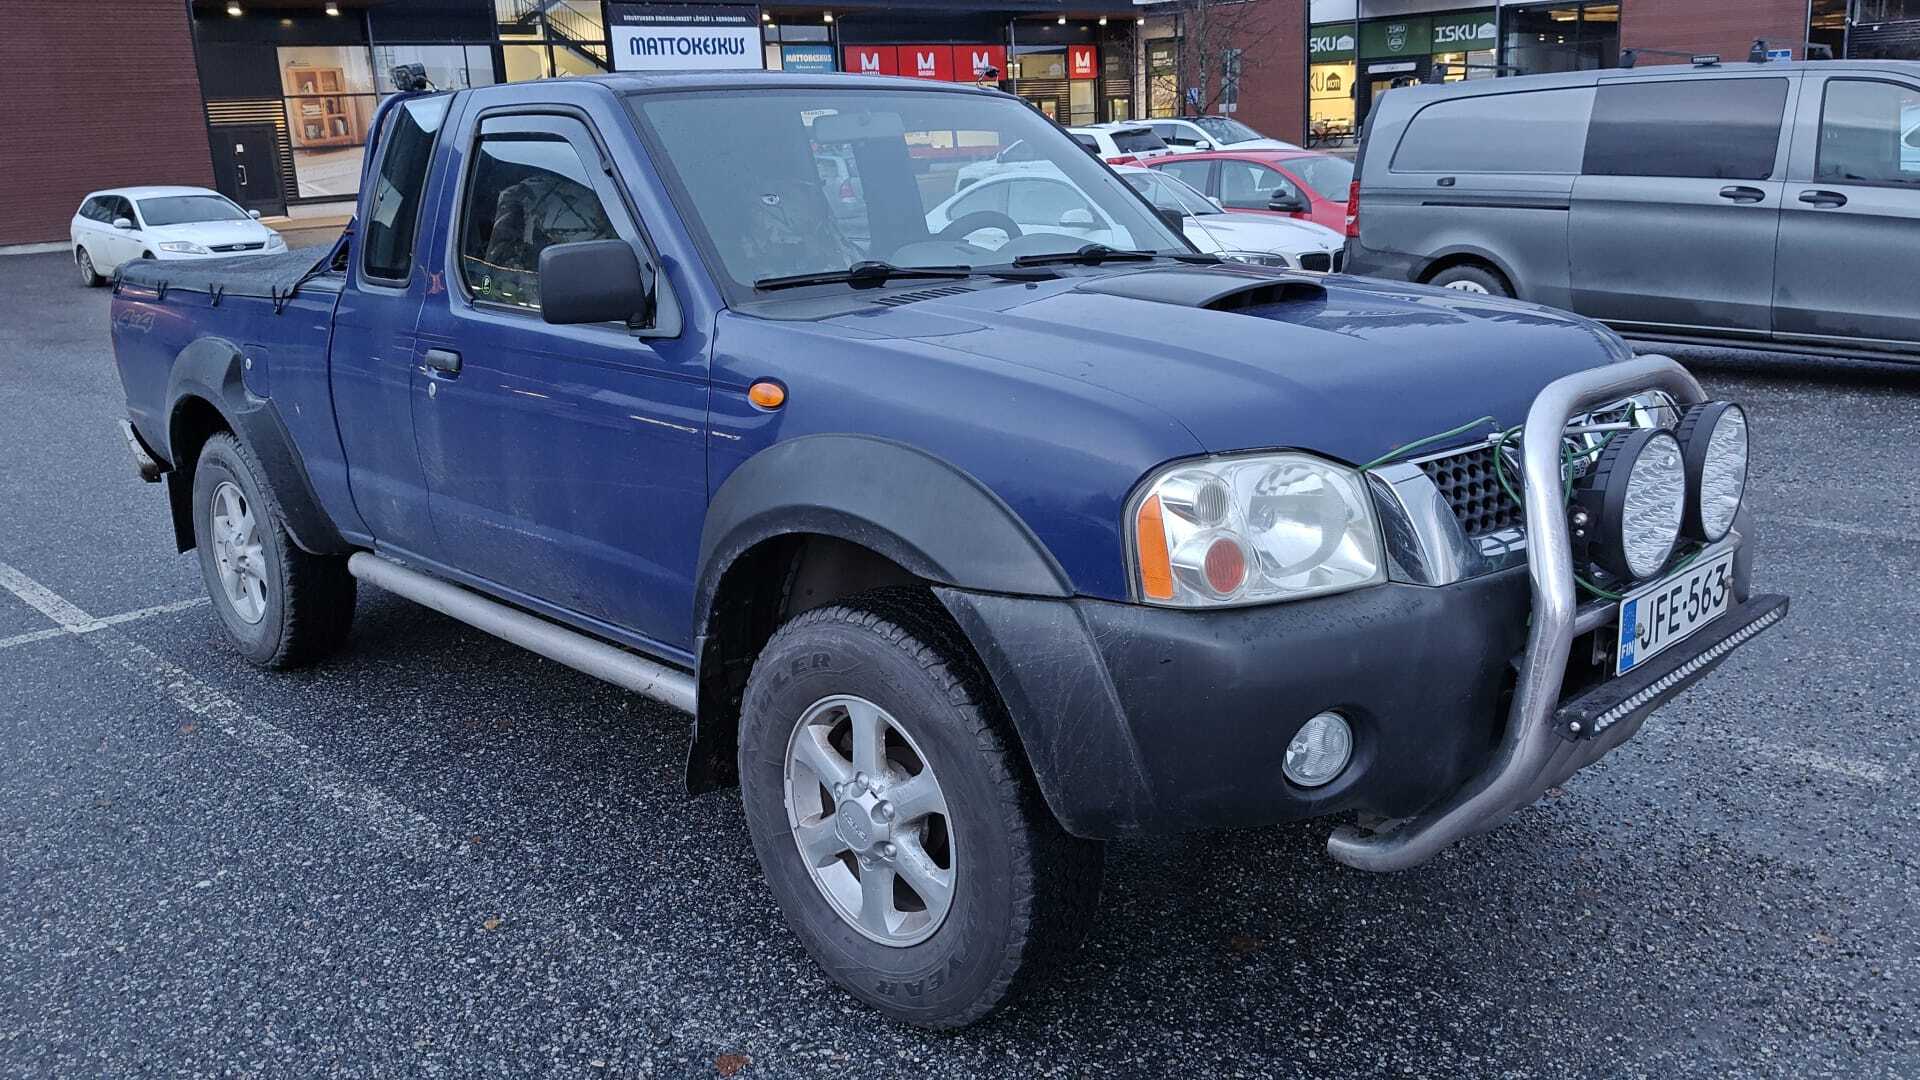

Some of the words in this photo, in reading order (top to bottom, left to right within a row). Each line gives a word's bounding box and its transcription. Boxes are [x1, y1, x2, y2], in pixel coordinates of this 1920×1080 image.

[1387, 24, 1405, 33] ISKU
[1434, 24, 1477, 43] ISKU
[630, 37, 745, 55] MATTOKESKUS
[861, 52, 879, 70] M
[917, 52, 935, 69] M
[972, 51, 989, 68] M
[1075, 51, 1090, 67] M
[1641, 563, 1727, 650] JFE-563
[1621, 640, 1636, 659] FIN
